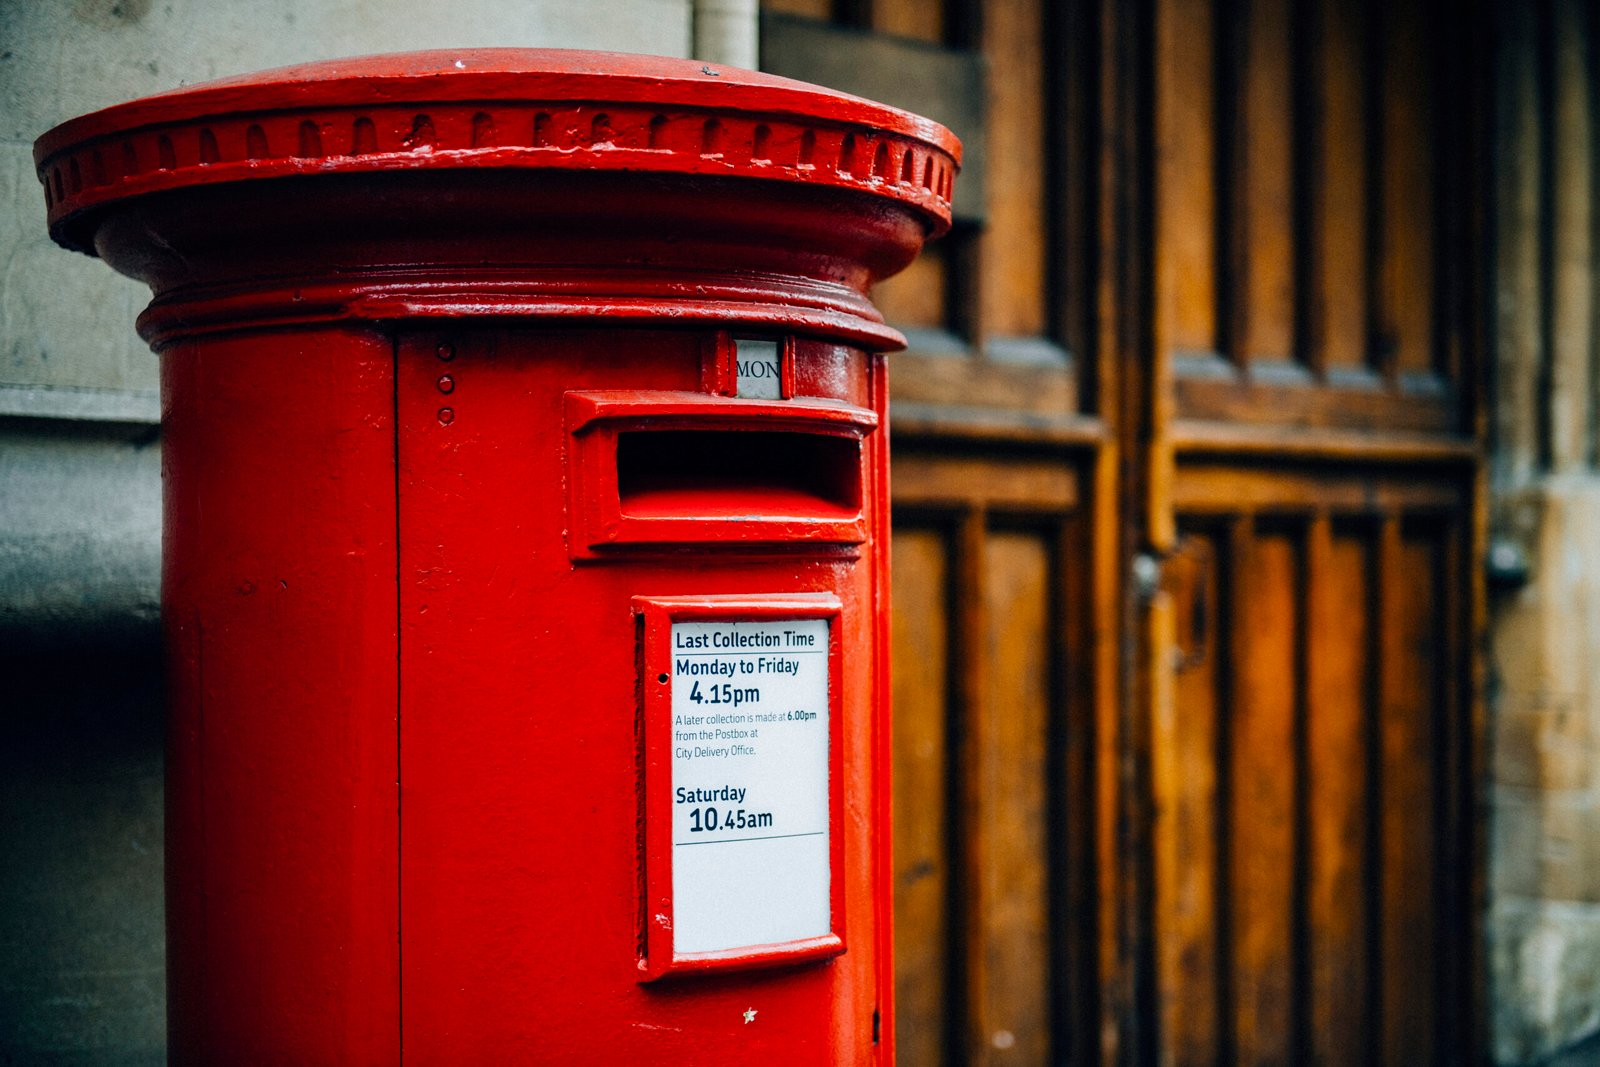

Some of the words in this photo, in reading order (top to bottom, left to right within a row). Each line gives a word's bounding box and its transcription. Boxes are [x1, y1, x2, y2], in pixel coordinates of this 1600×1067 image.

[736, 360, 779, 378] MON
[676, 632, 709, 648] Last
[713, 631, 780, 647] Collection
[784, 631, 814, 646] Time
[676, 659, 736, 677] Monday
[740, 660, 754, 674] to
[758, 657, 799, 676] Friday
[690, 681, 760, 707] 4.15pm
[675, 715, 682, 725] A
[684, 715, 704, 725] later
[707, 713, 745, 724] collection
[748, 713, 753, 722] is
[756, 712, 777, 722] made
[779, 713, 786, 721] at
[787, 711, 817, 722] 6.00pm
[676, 731, 697, 741] from
[700, 730, 713, 740] the
[716, 729, 748, 739] Postbox
[750, 729, 758, 737] at
[676, 748, 692, 760] City
[695, 746, 729, 758] Delivery
[731, 745, 756, 756] Office.
[676, 785, 746, 803] Saturday
[690, 807, 773, 832] 10.45am
